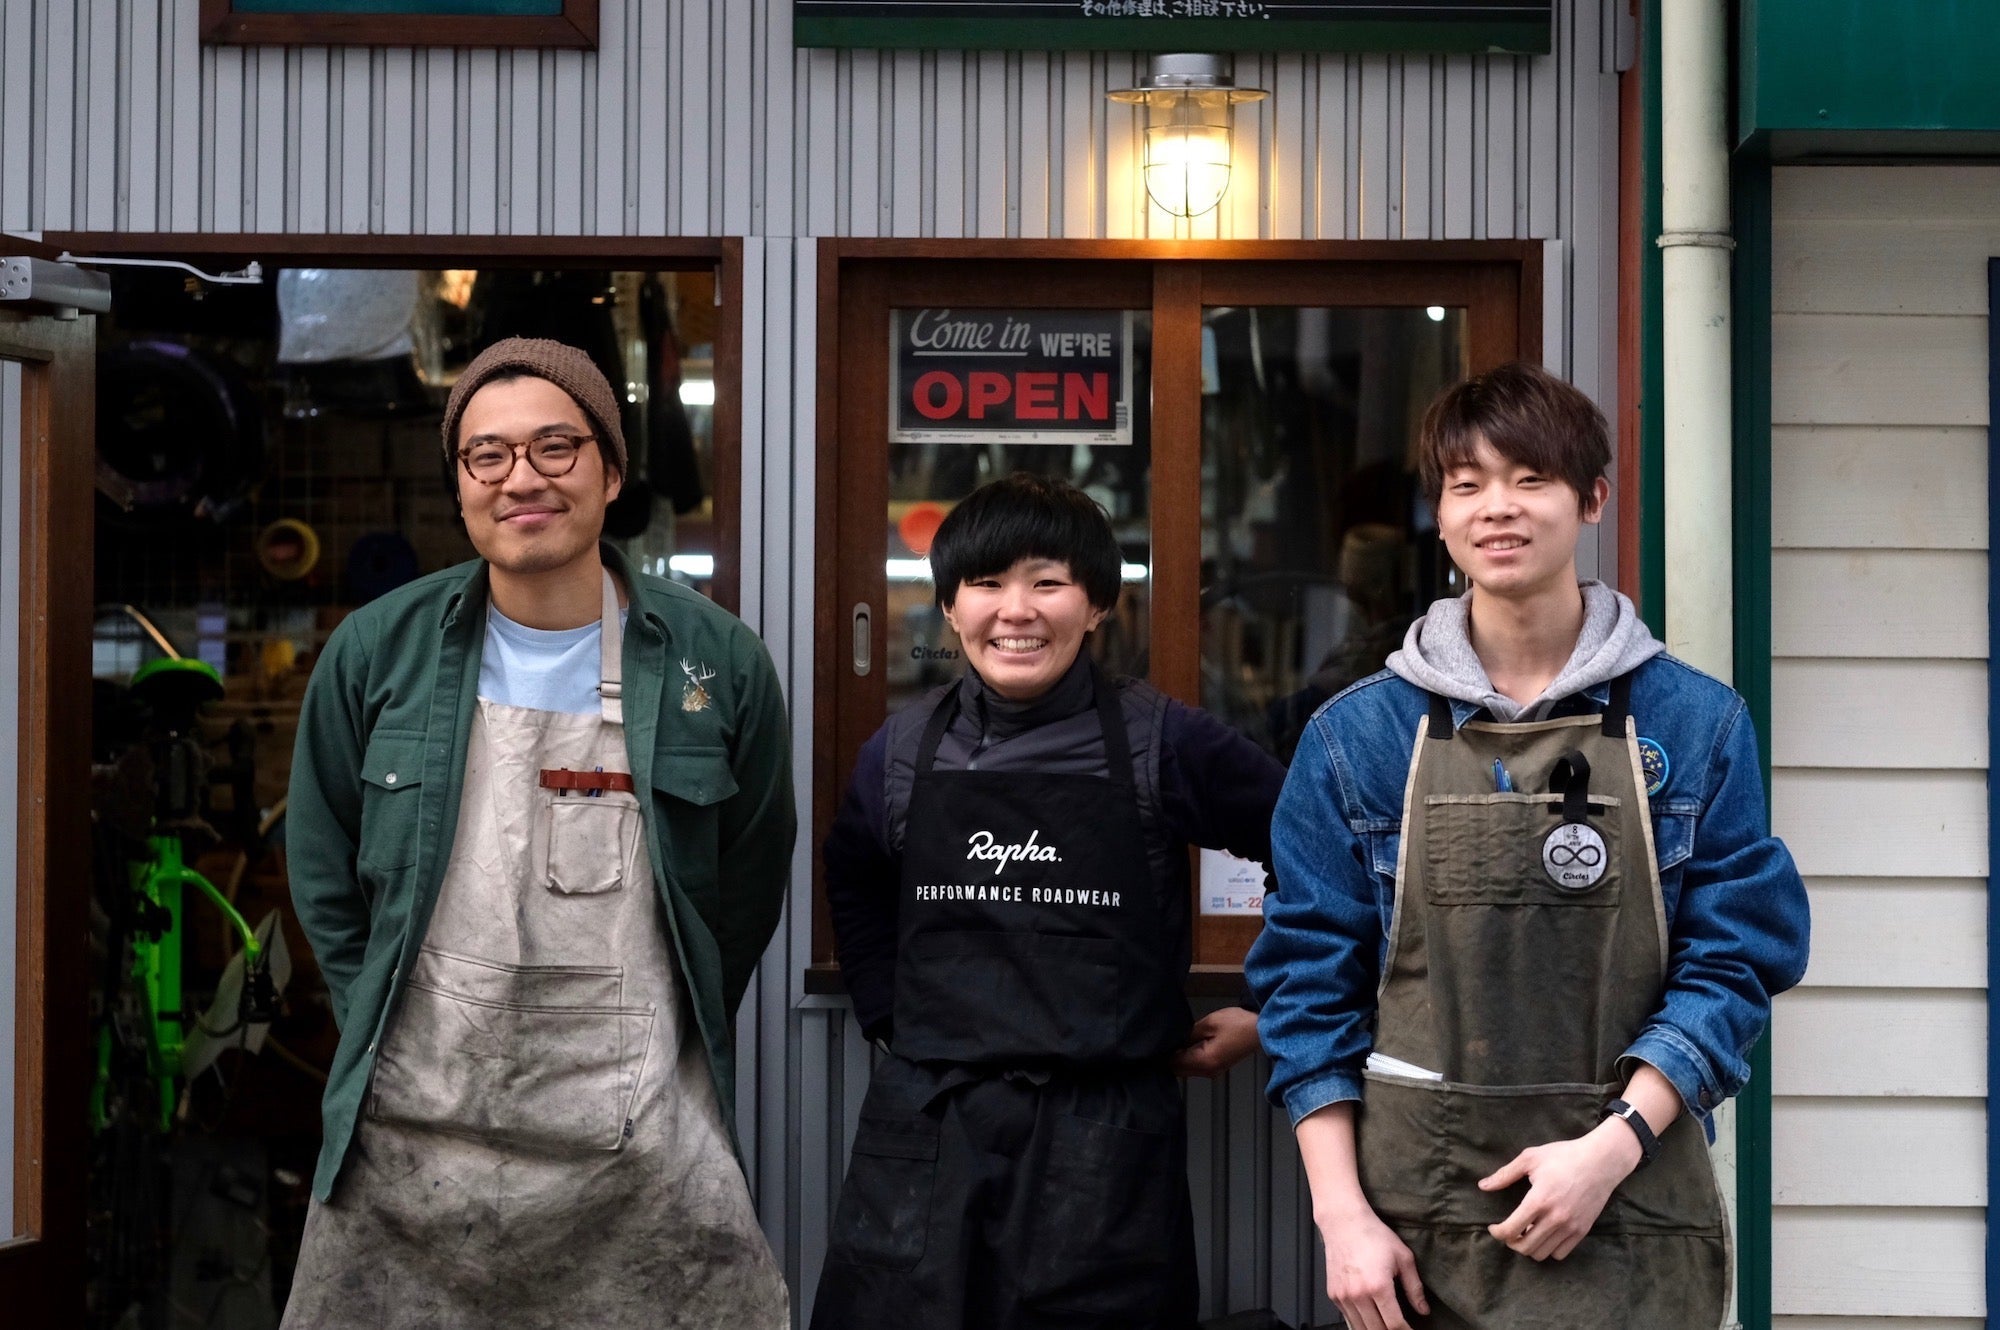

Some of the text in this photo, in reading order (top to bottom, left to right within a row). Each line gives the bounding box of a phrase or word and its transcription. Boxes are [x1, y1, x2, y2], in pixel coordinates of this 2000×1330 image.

[910, 309, 1112, 358] Come in WE'RE
[912, 370, 1109, 420] OPEN
[916, 885, 1121, 907] PERFORMANCE ROADWEAR
